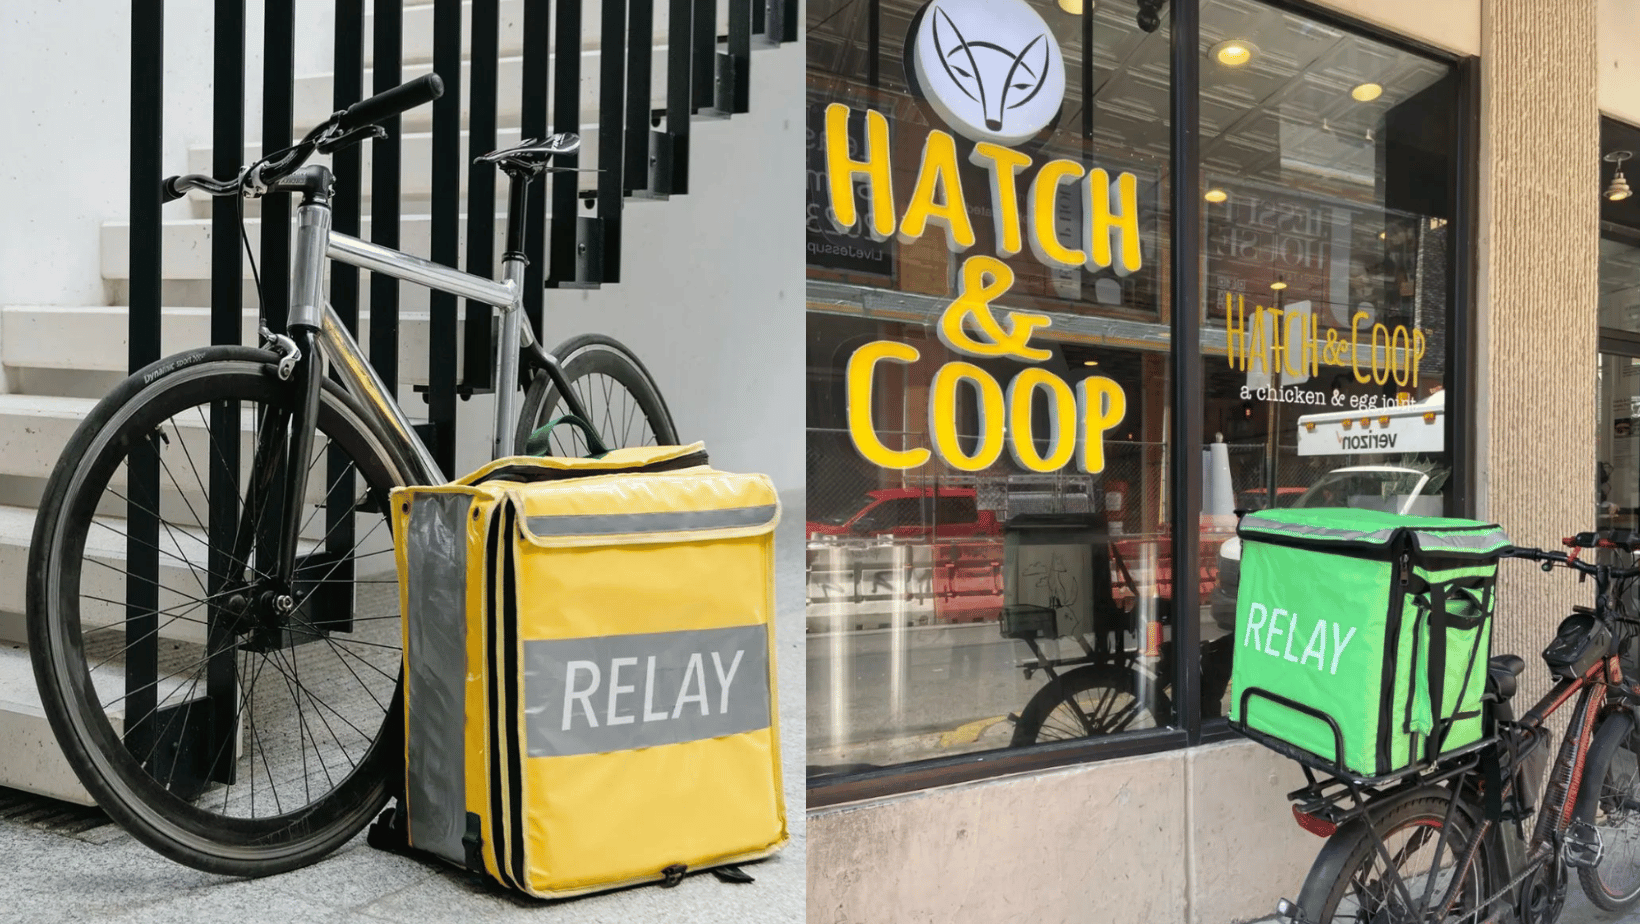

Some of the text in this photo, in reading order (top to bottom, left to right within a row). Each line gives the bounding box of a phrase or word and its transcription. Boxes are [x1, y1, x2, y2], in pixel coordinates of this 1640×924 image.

[825, 102, 1141, 274] HATCH
[937, 254, 1052, 362] &
[1226, 292, 1426, 388] HATCH & COOP
[846, 340, 1126, 474] COOP
[1240, 384, 1417, 412] a chicken & egg joint
[1243, 602, 1357, 675] RELAY
[561, 650, 745, 731] RELAY
